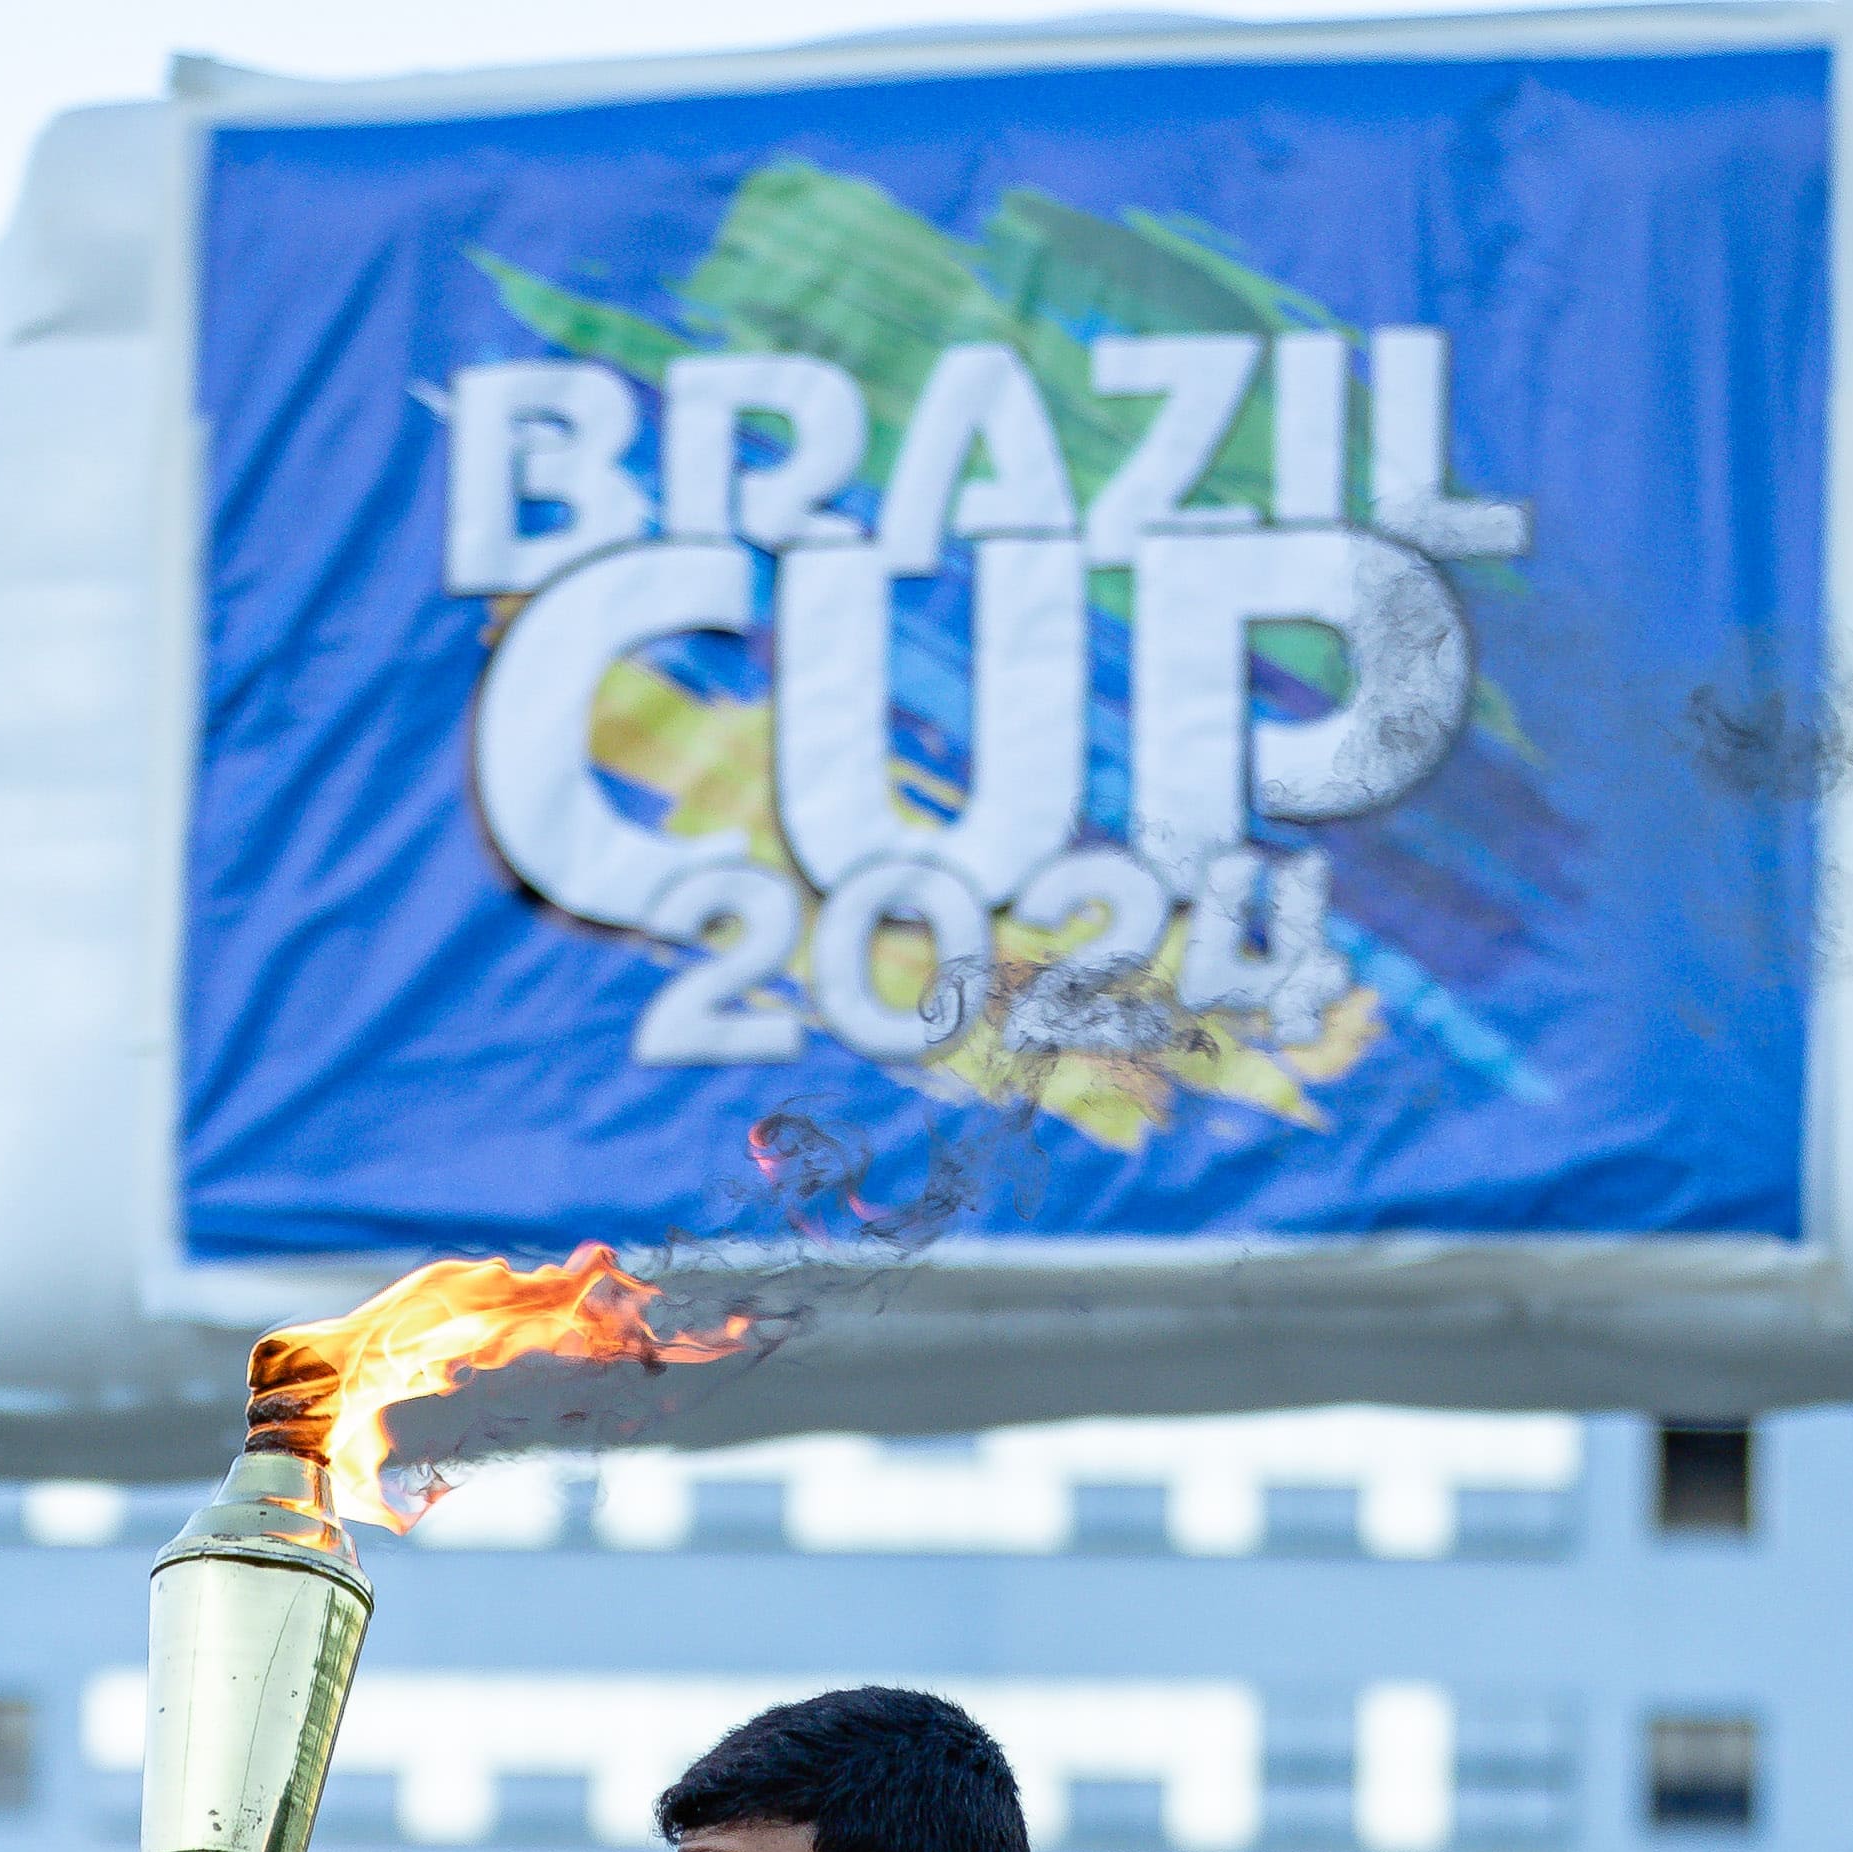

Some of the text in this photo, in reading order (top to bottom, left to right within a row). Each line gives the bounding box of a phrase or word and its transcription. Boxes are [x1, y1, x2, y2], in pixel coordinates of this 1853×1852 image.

[444, 326, 1534, 597] BRAZIL
[472, 526, 1473, 932] CUP
[632, 847, 1353, 1067] 2024
